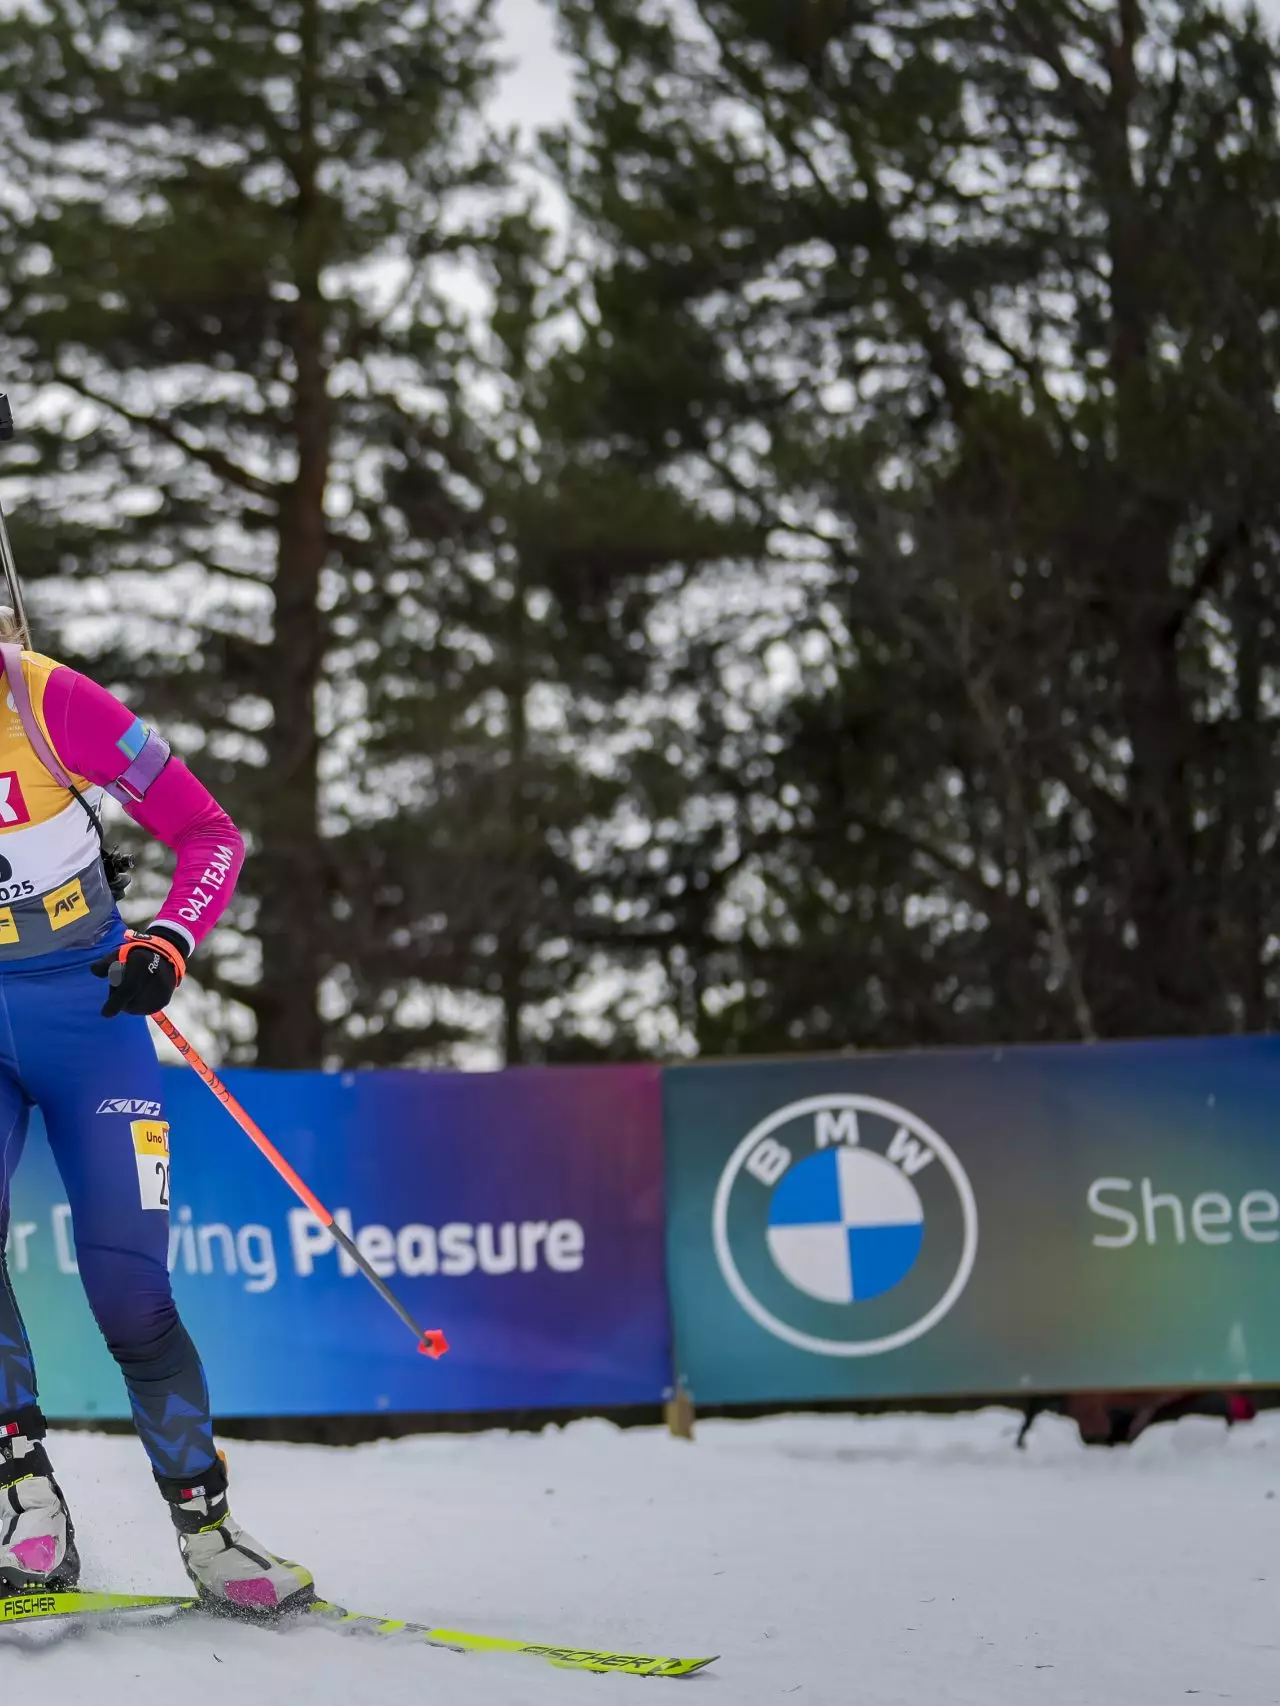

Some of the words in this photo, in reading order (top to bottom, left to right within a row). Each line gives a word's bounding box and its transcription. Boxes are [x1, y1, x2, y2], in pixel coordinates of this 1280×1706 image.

[53, 891, 81, 918] AF
[178, 886, 214, 922] QAZ
[201, 844, 234, 890] TEAM
[146, 1131, 163, 1144] Uno
[746, 1109, 934, 1186] BMW
[155, 1161, 170, 1206] 2
[1086, 1178, 1280, 1249] Shee
[288, 1206, 585, 1278] Pleasure
[4, 1597, 57, 1617] FISCHER
[521, 1645, 657, 1669] FISCHER
